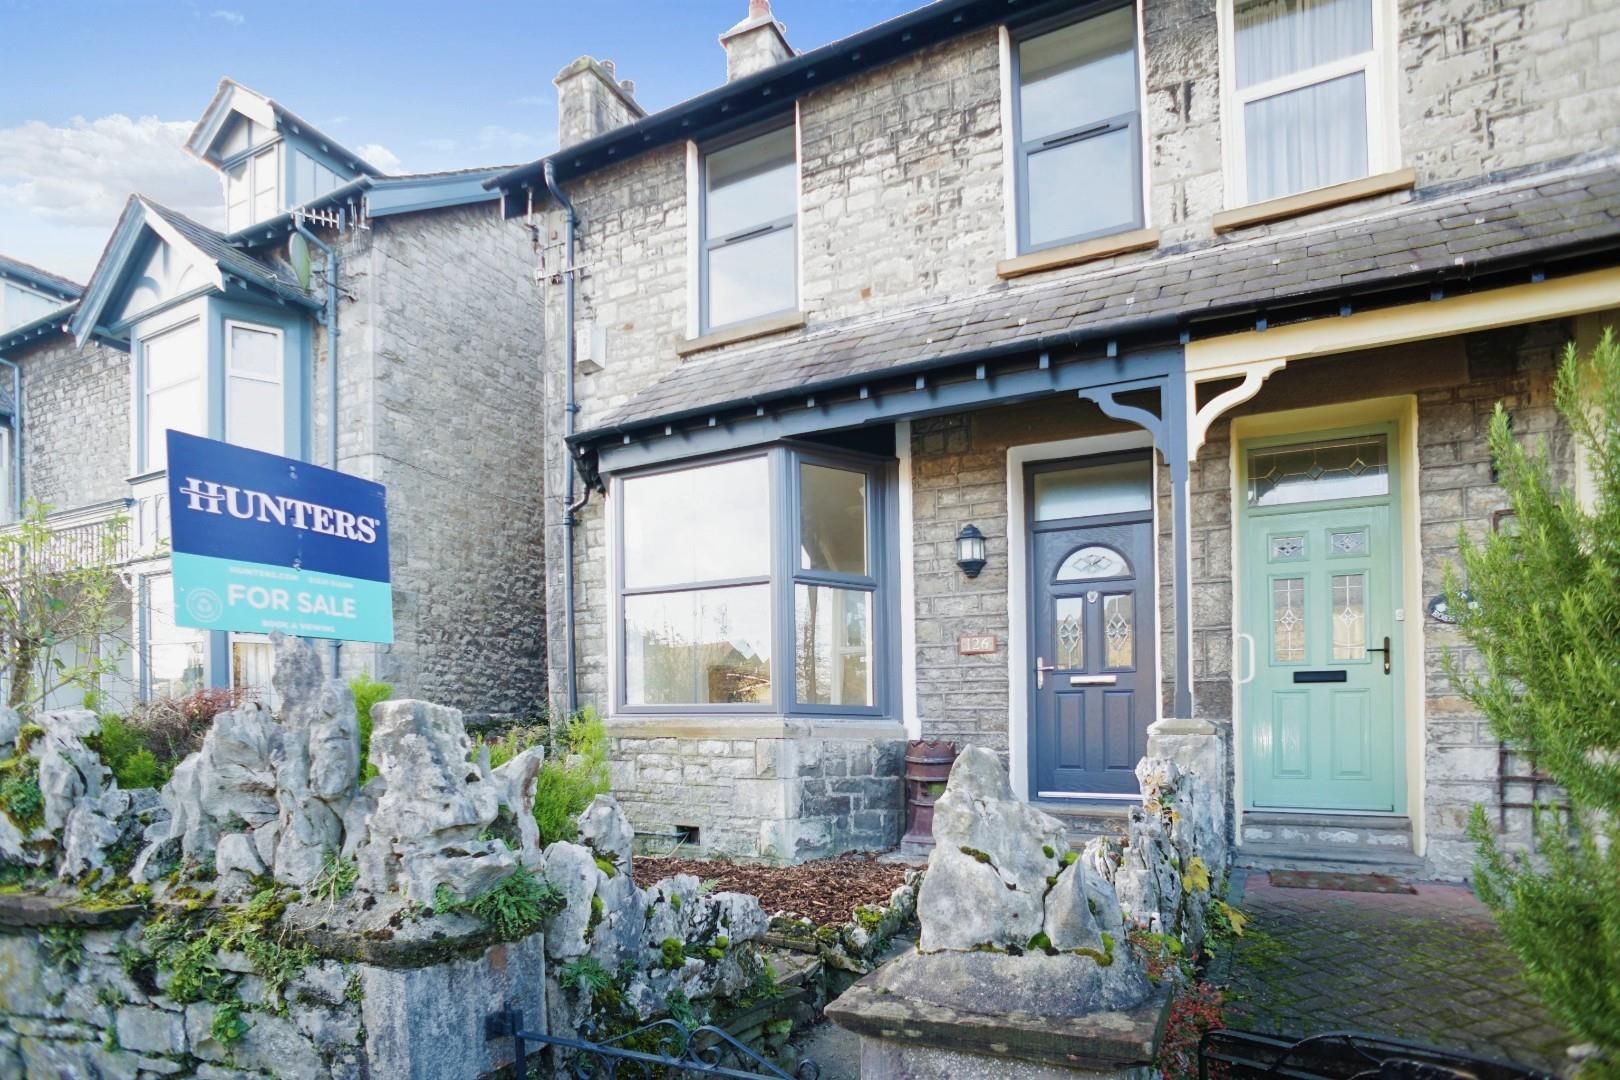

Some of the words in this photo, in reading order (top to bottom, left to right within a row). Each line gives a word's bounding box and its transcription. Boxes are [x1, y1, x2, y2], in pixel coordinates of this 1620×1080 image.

[179, 477, 378, 544] HUNTERS
[228, 583, 290, 611] FOR
[297, 591, 357, 619] SALE
[967, 638, 990, 650] 126
